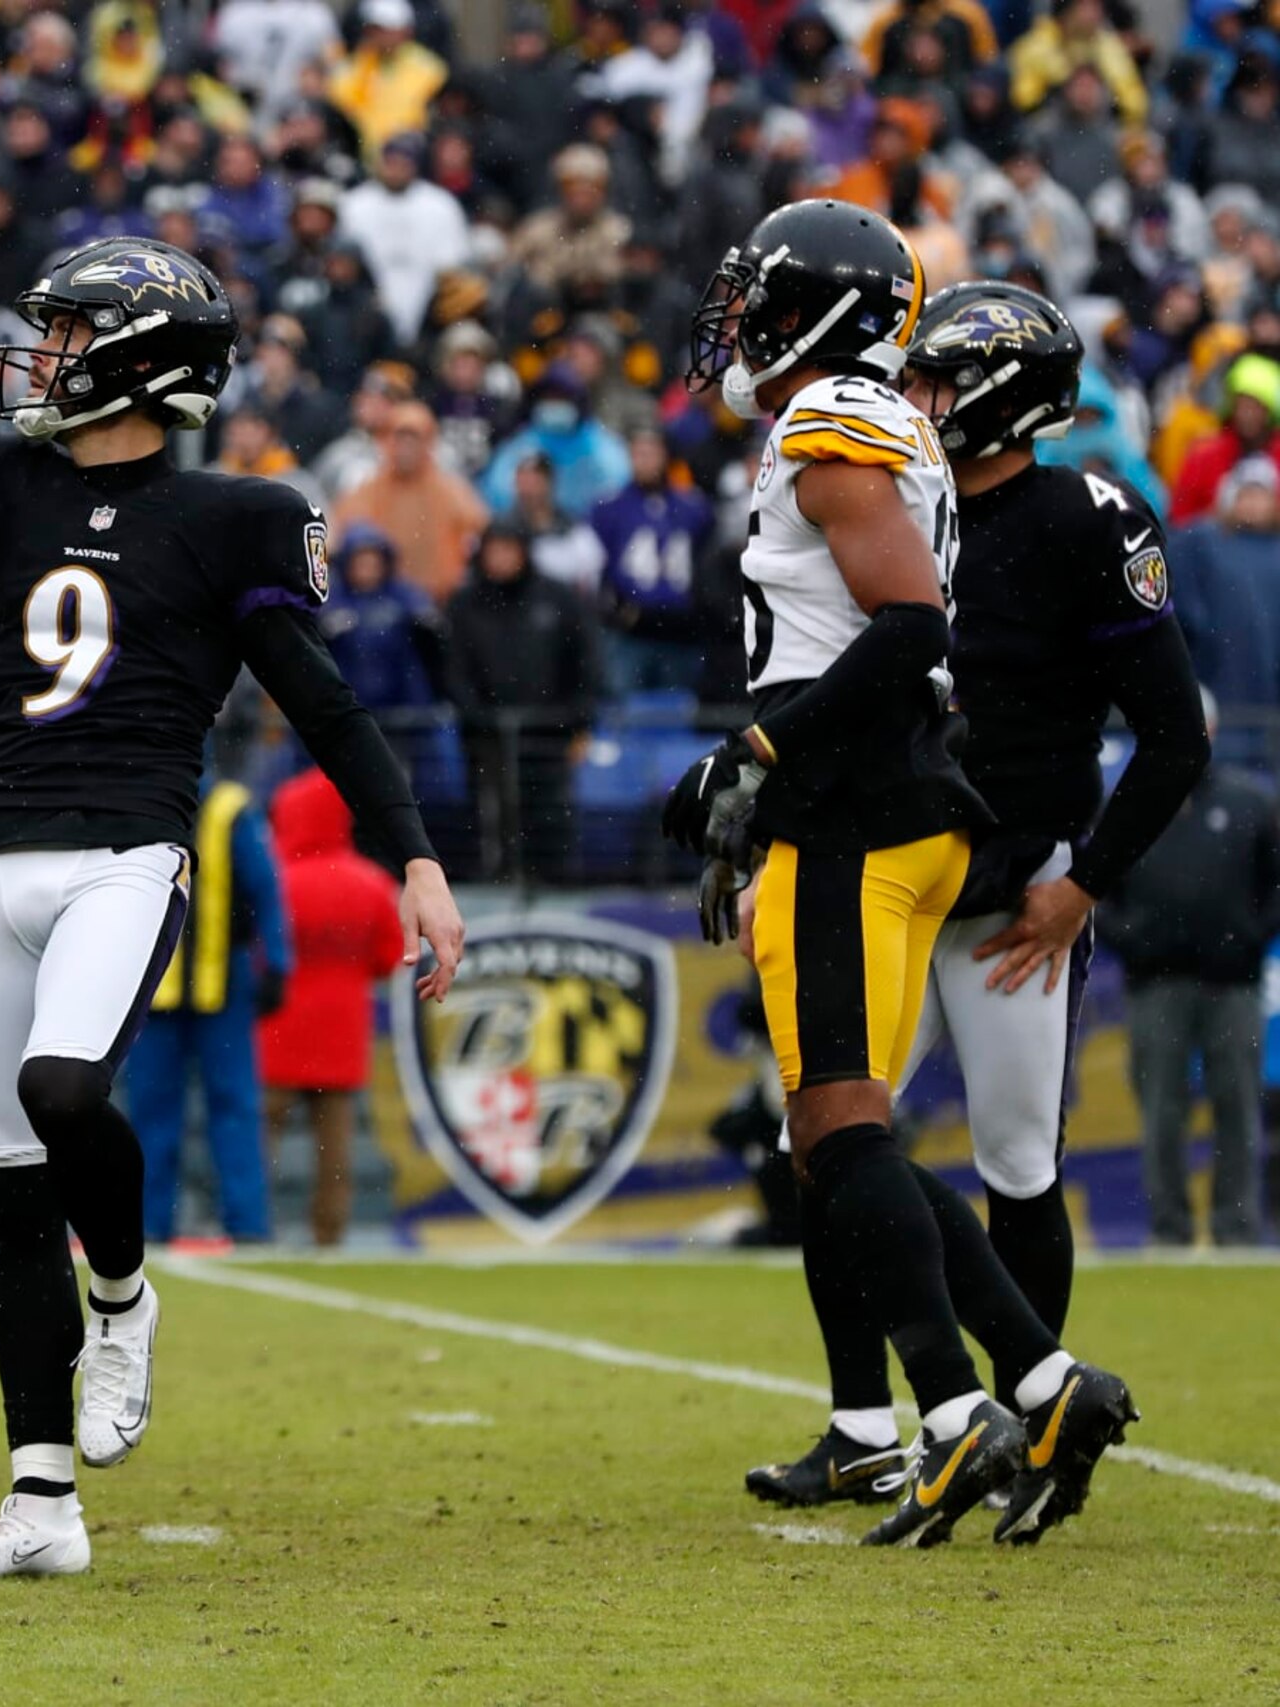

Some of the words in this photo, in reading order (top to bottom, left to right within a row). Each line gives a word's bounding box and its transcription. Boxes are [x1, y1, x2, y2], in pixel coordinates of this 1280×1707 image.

[1083, 472, 1129, 511] 4
[63, 547, 121, 562] RAVENS
[21, 565, 118, 722] 9
